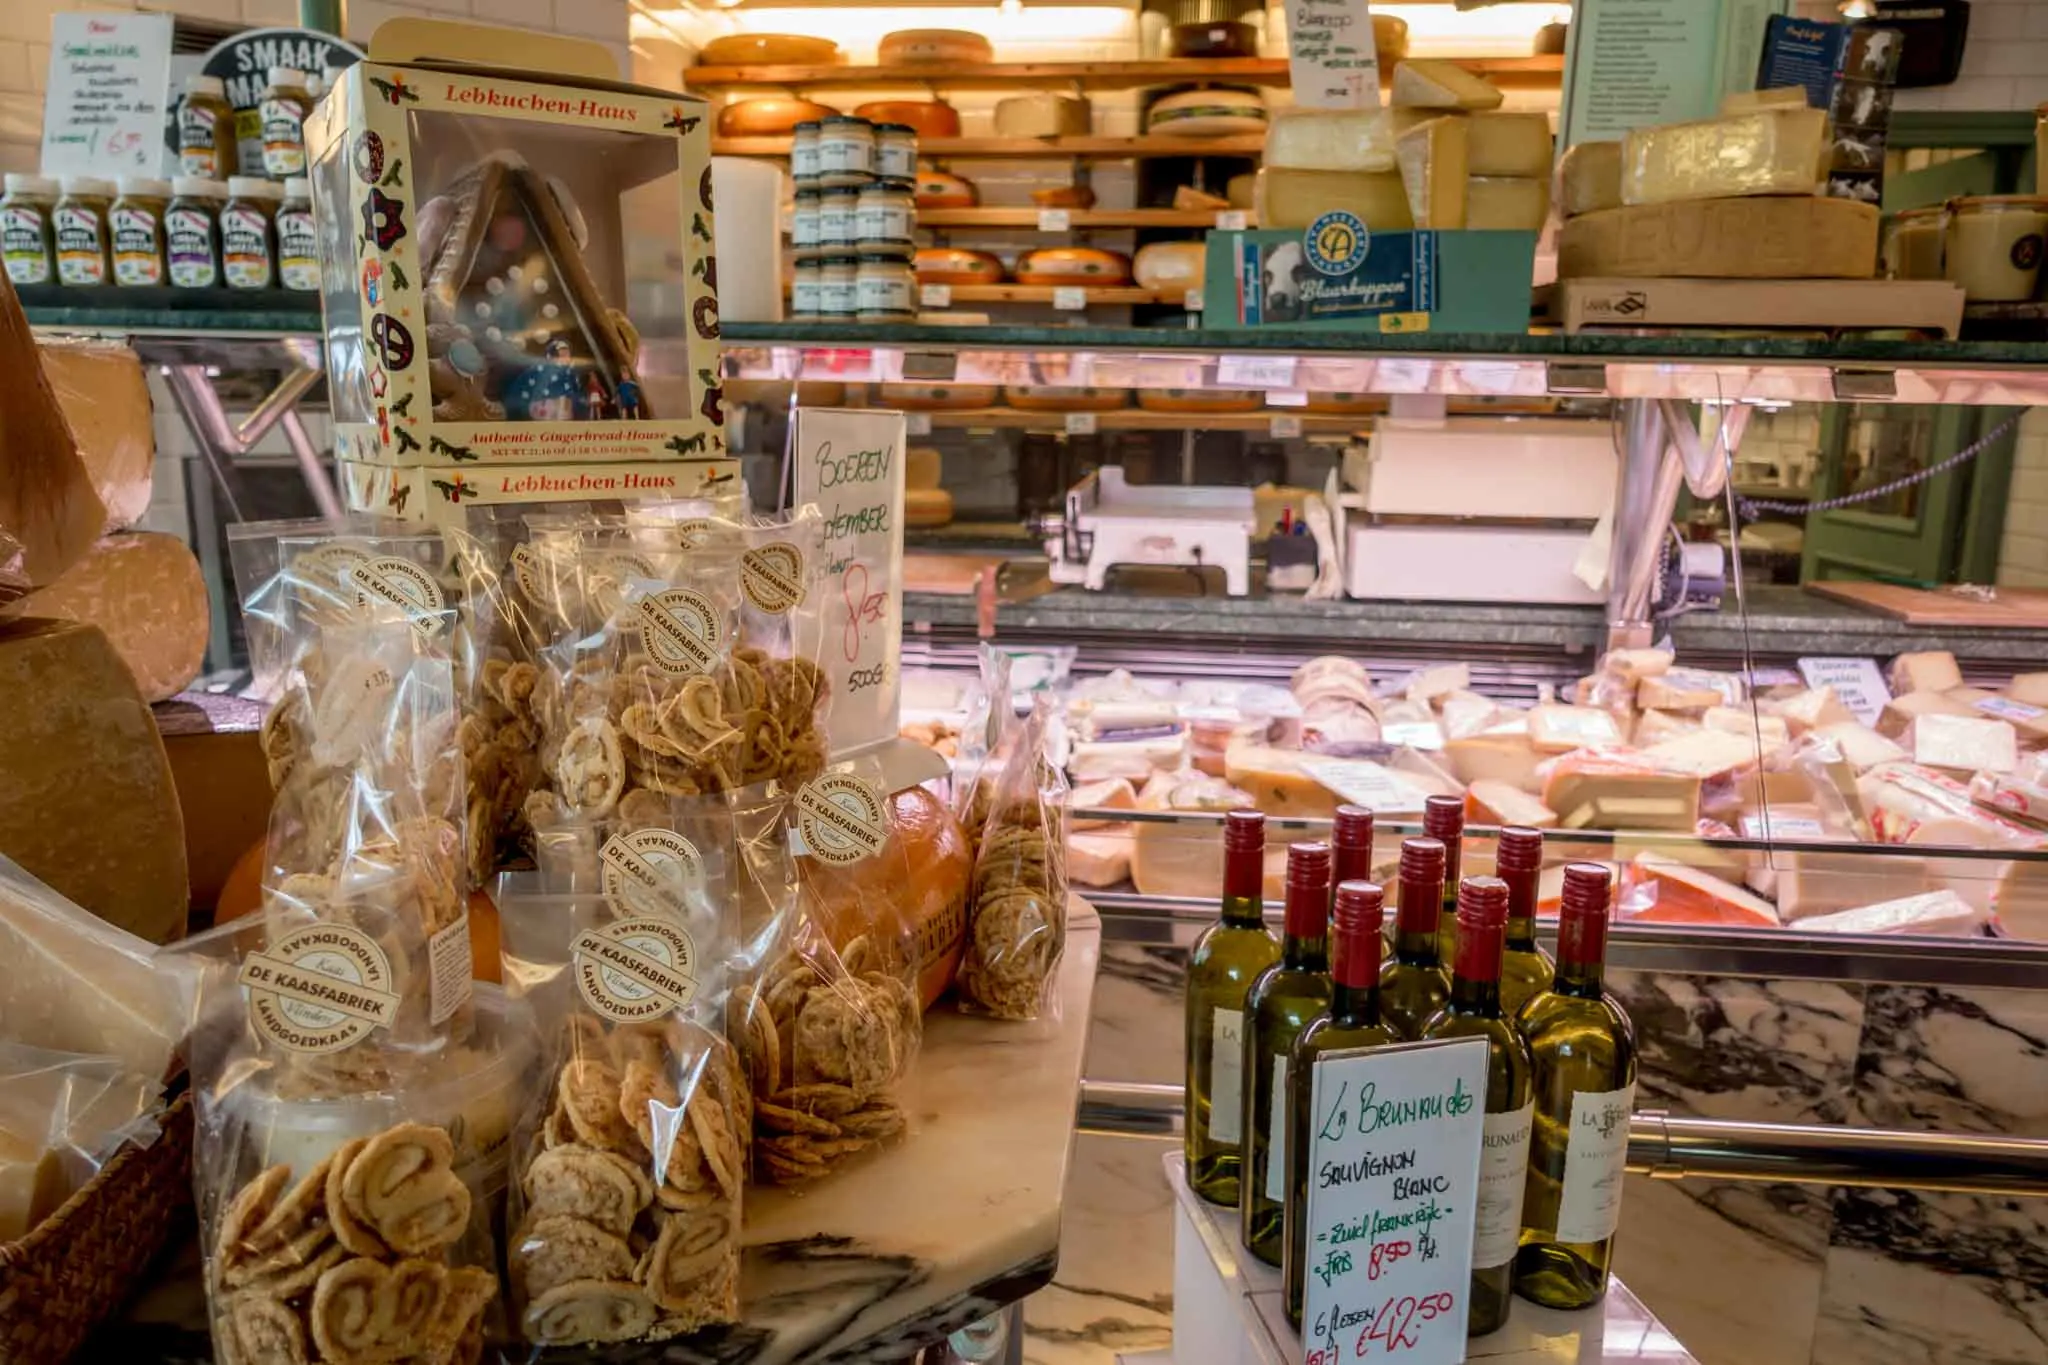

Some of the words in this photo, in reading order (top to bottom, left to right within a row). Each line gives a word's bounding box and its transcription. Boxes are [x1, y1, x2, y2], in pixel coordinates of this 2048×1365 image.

[234, 38, 331, 73] SMAAK
[446, 84, 638, 121] Lebkuchen-Haus
[469, 432, 535, 444] Authentic
[501, 473, 676, 494] Lebkuchen-Haus
[816, 442, 892, 492] BOEREN
[355, 569, 370, 585] DE
[377, 563, 437, 607] LANDGOEDKAAS
[641, 600, 654, 616] DE
[654, 609, 711, 665] KAASFABRIEK
[664, 594, 715, 642] LANDGOEDKAAS
[643, 625, 691, 673] LANDGOEDKAAS
[801, 793, 814, 809] DE
[815, 802, 879, 847] KAASFABRIEK
[821, 779, 879, 823] LANDGOEDKAAS
[608, 845, 623, 863] DE
[803, 818, 861, 862] LANDGOEDKAAS
[282, 933, 380, 982] LANDGOEDKAAS
[613, 923, 689, 966] LANDGOEDKAAS
[580, 938, 597, 951] DE
[600, 944, 687, 998] KAASFABRIEK
[583, 964, 662, 1016] LANDGOEDKAAS
[249, 965, 272, 981] DE
[275, 972, 385, 1016] KAASFABRIEK
[257, 998, 358, 1047] LANDGOEDKAAS
[1582, 1110, 1598, 1126] LA
[1319, 1149, 1416, 1188] SAUVIGNON
[1393, 1175, 1450, 1202] BLANC
